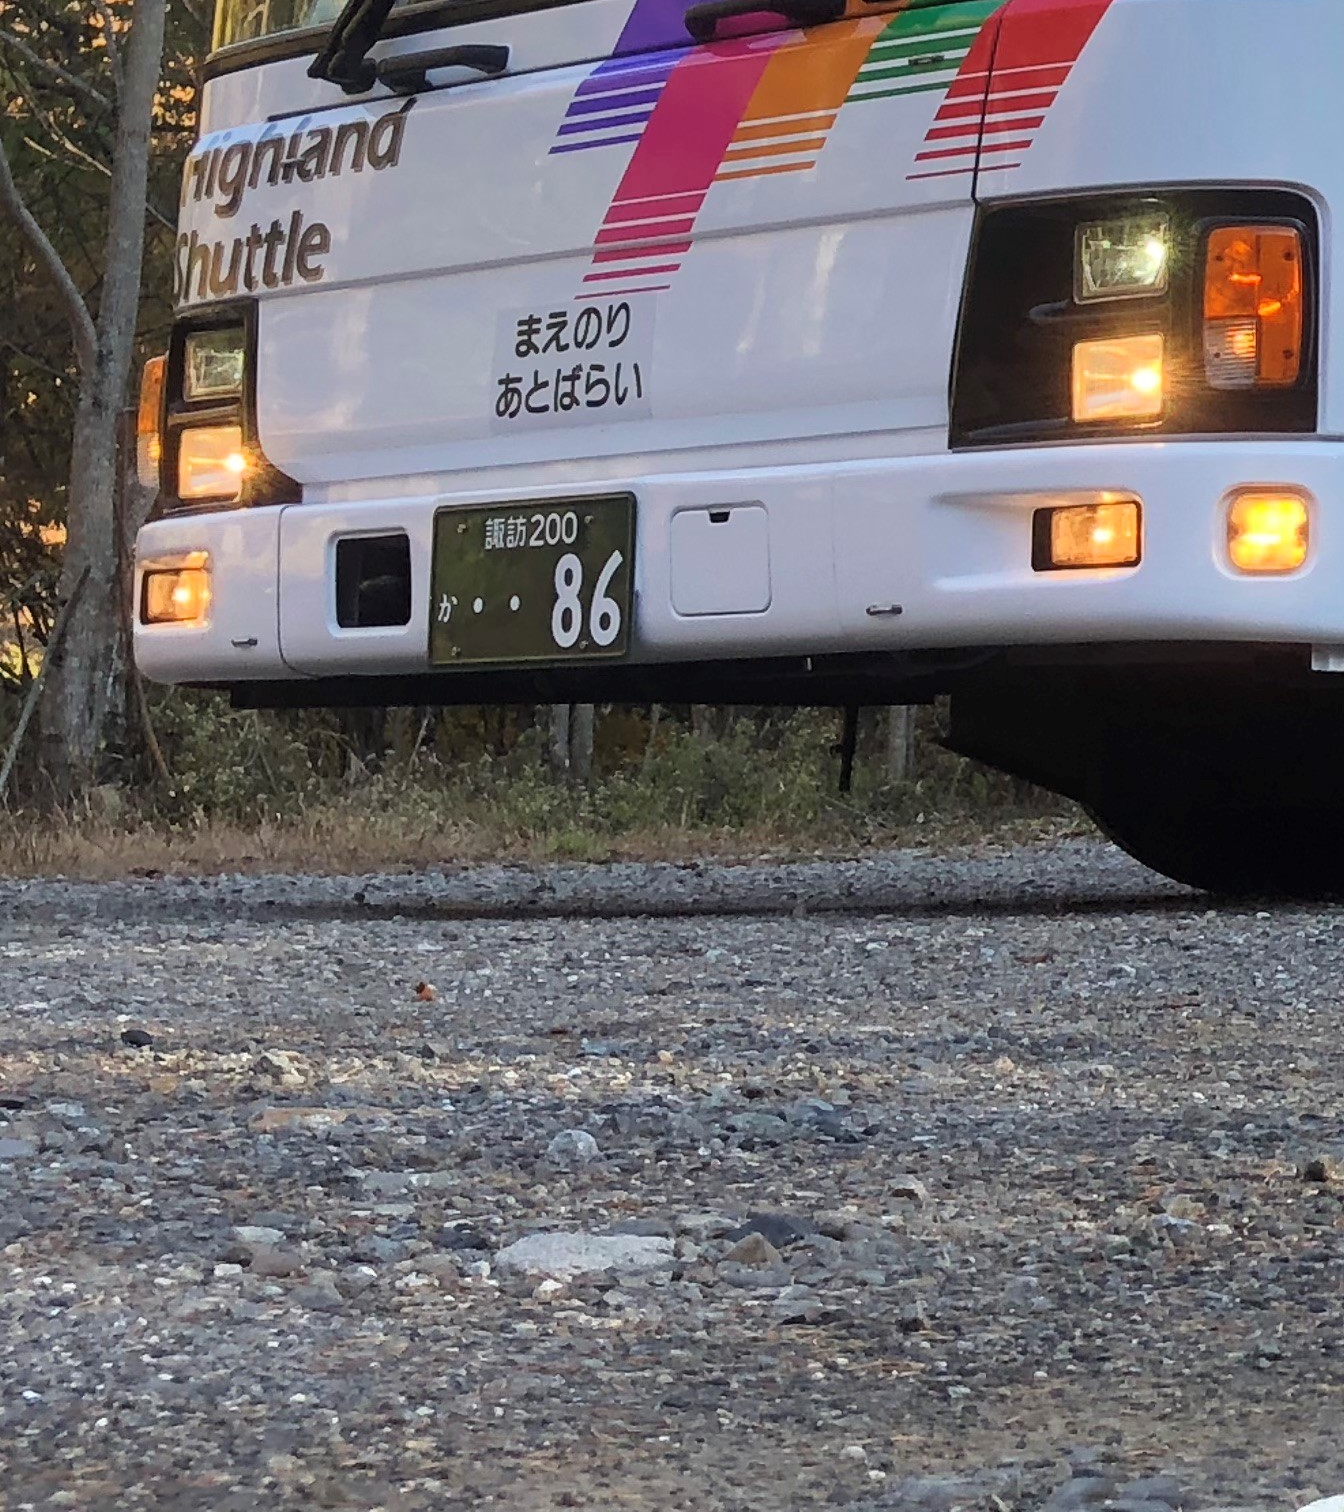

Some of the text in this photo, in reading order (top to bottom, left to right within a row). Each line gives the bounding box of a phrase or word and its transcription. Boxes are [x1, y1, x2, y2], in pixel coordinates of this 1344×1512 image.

[515, 302, 631, 358] まえのり
[495, 362, 643, 419] あとばらい
